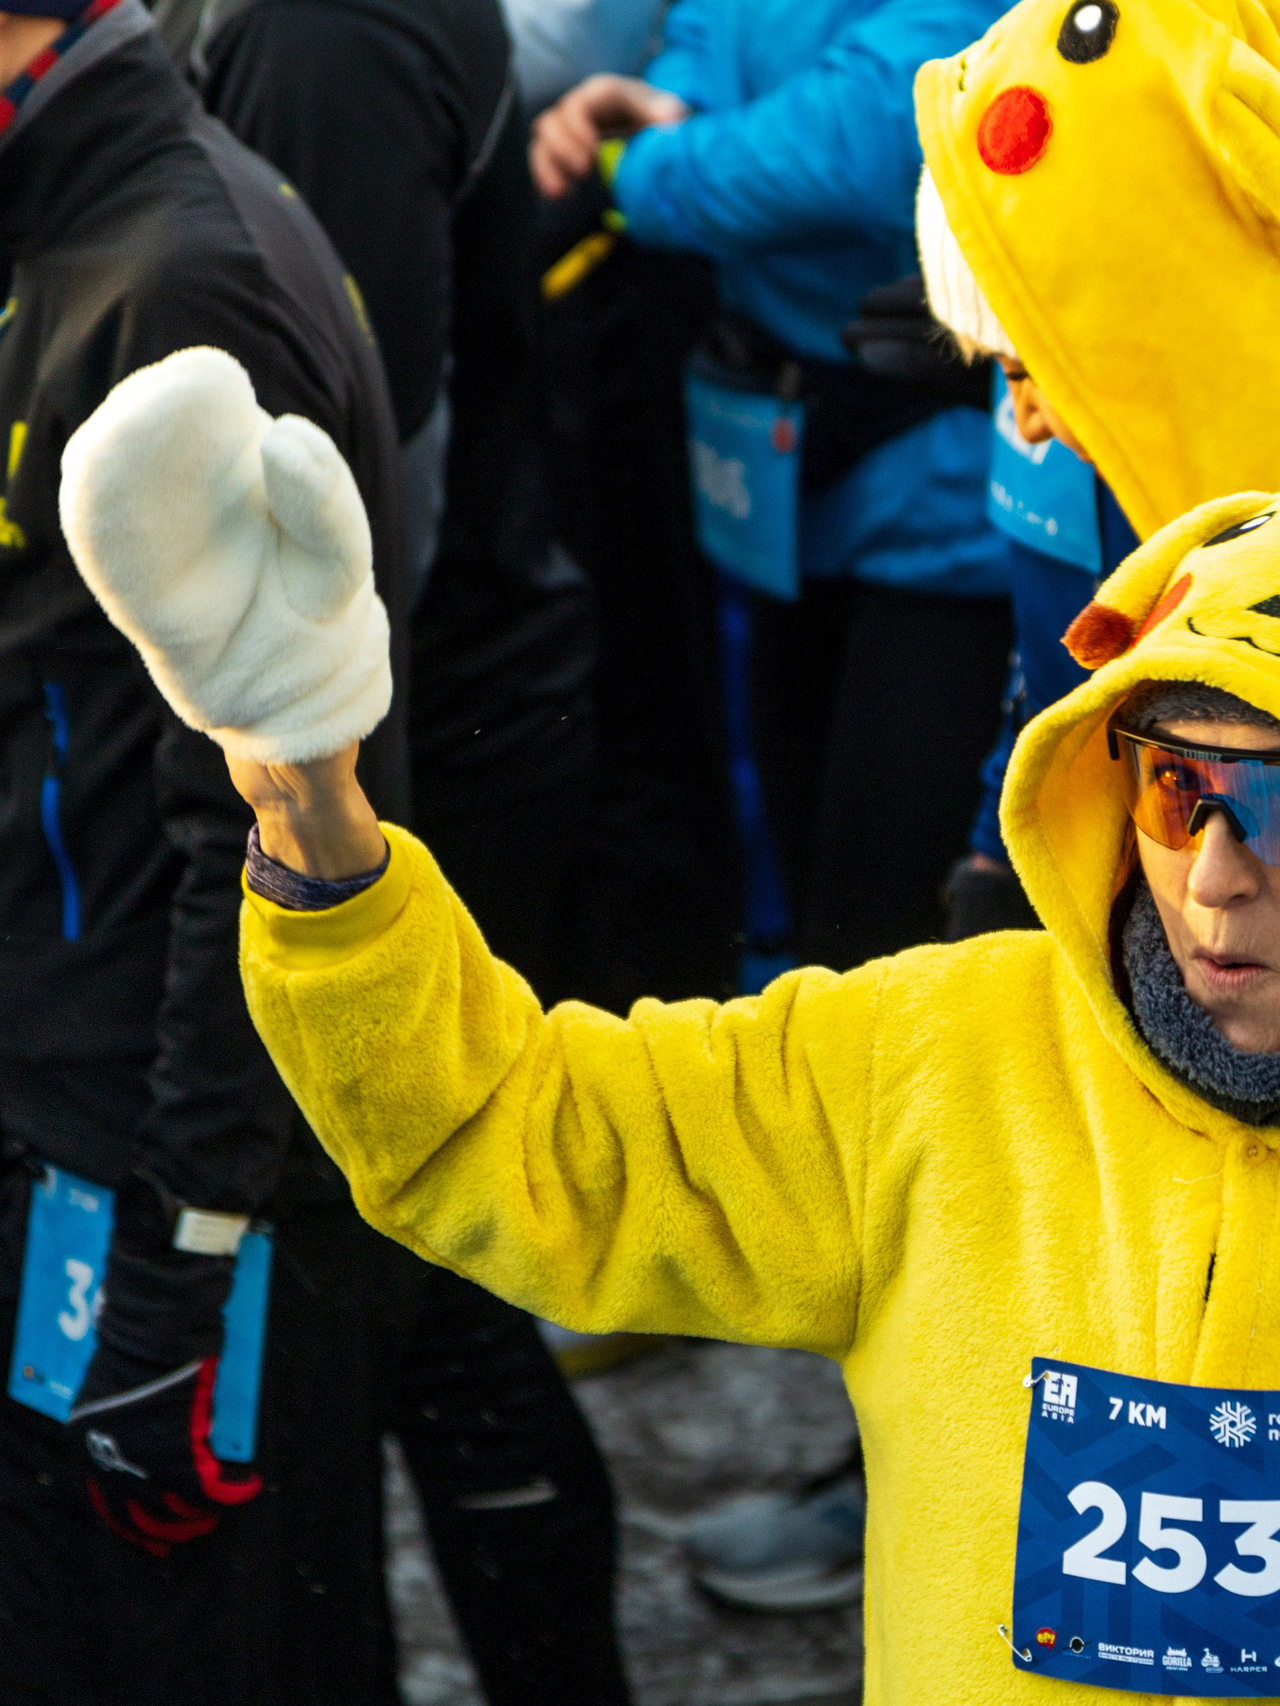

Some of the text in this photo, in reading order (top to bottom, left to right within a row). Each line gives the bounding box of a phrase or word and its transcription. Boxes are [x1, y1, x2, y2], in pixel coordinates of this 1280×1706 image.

[1042, 1402, 1075, 1417] EUROPE
[1109, 1396, 1123, 1420] 7
[1098, 1642, 1155, 1659] ВИКТОРИЯ
[1162, 1655, 1192, 1668] GORILLA
